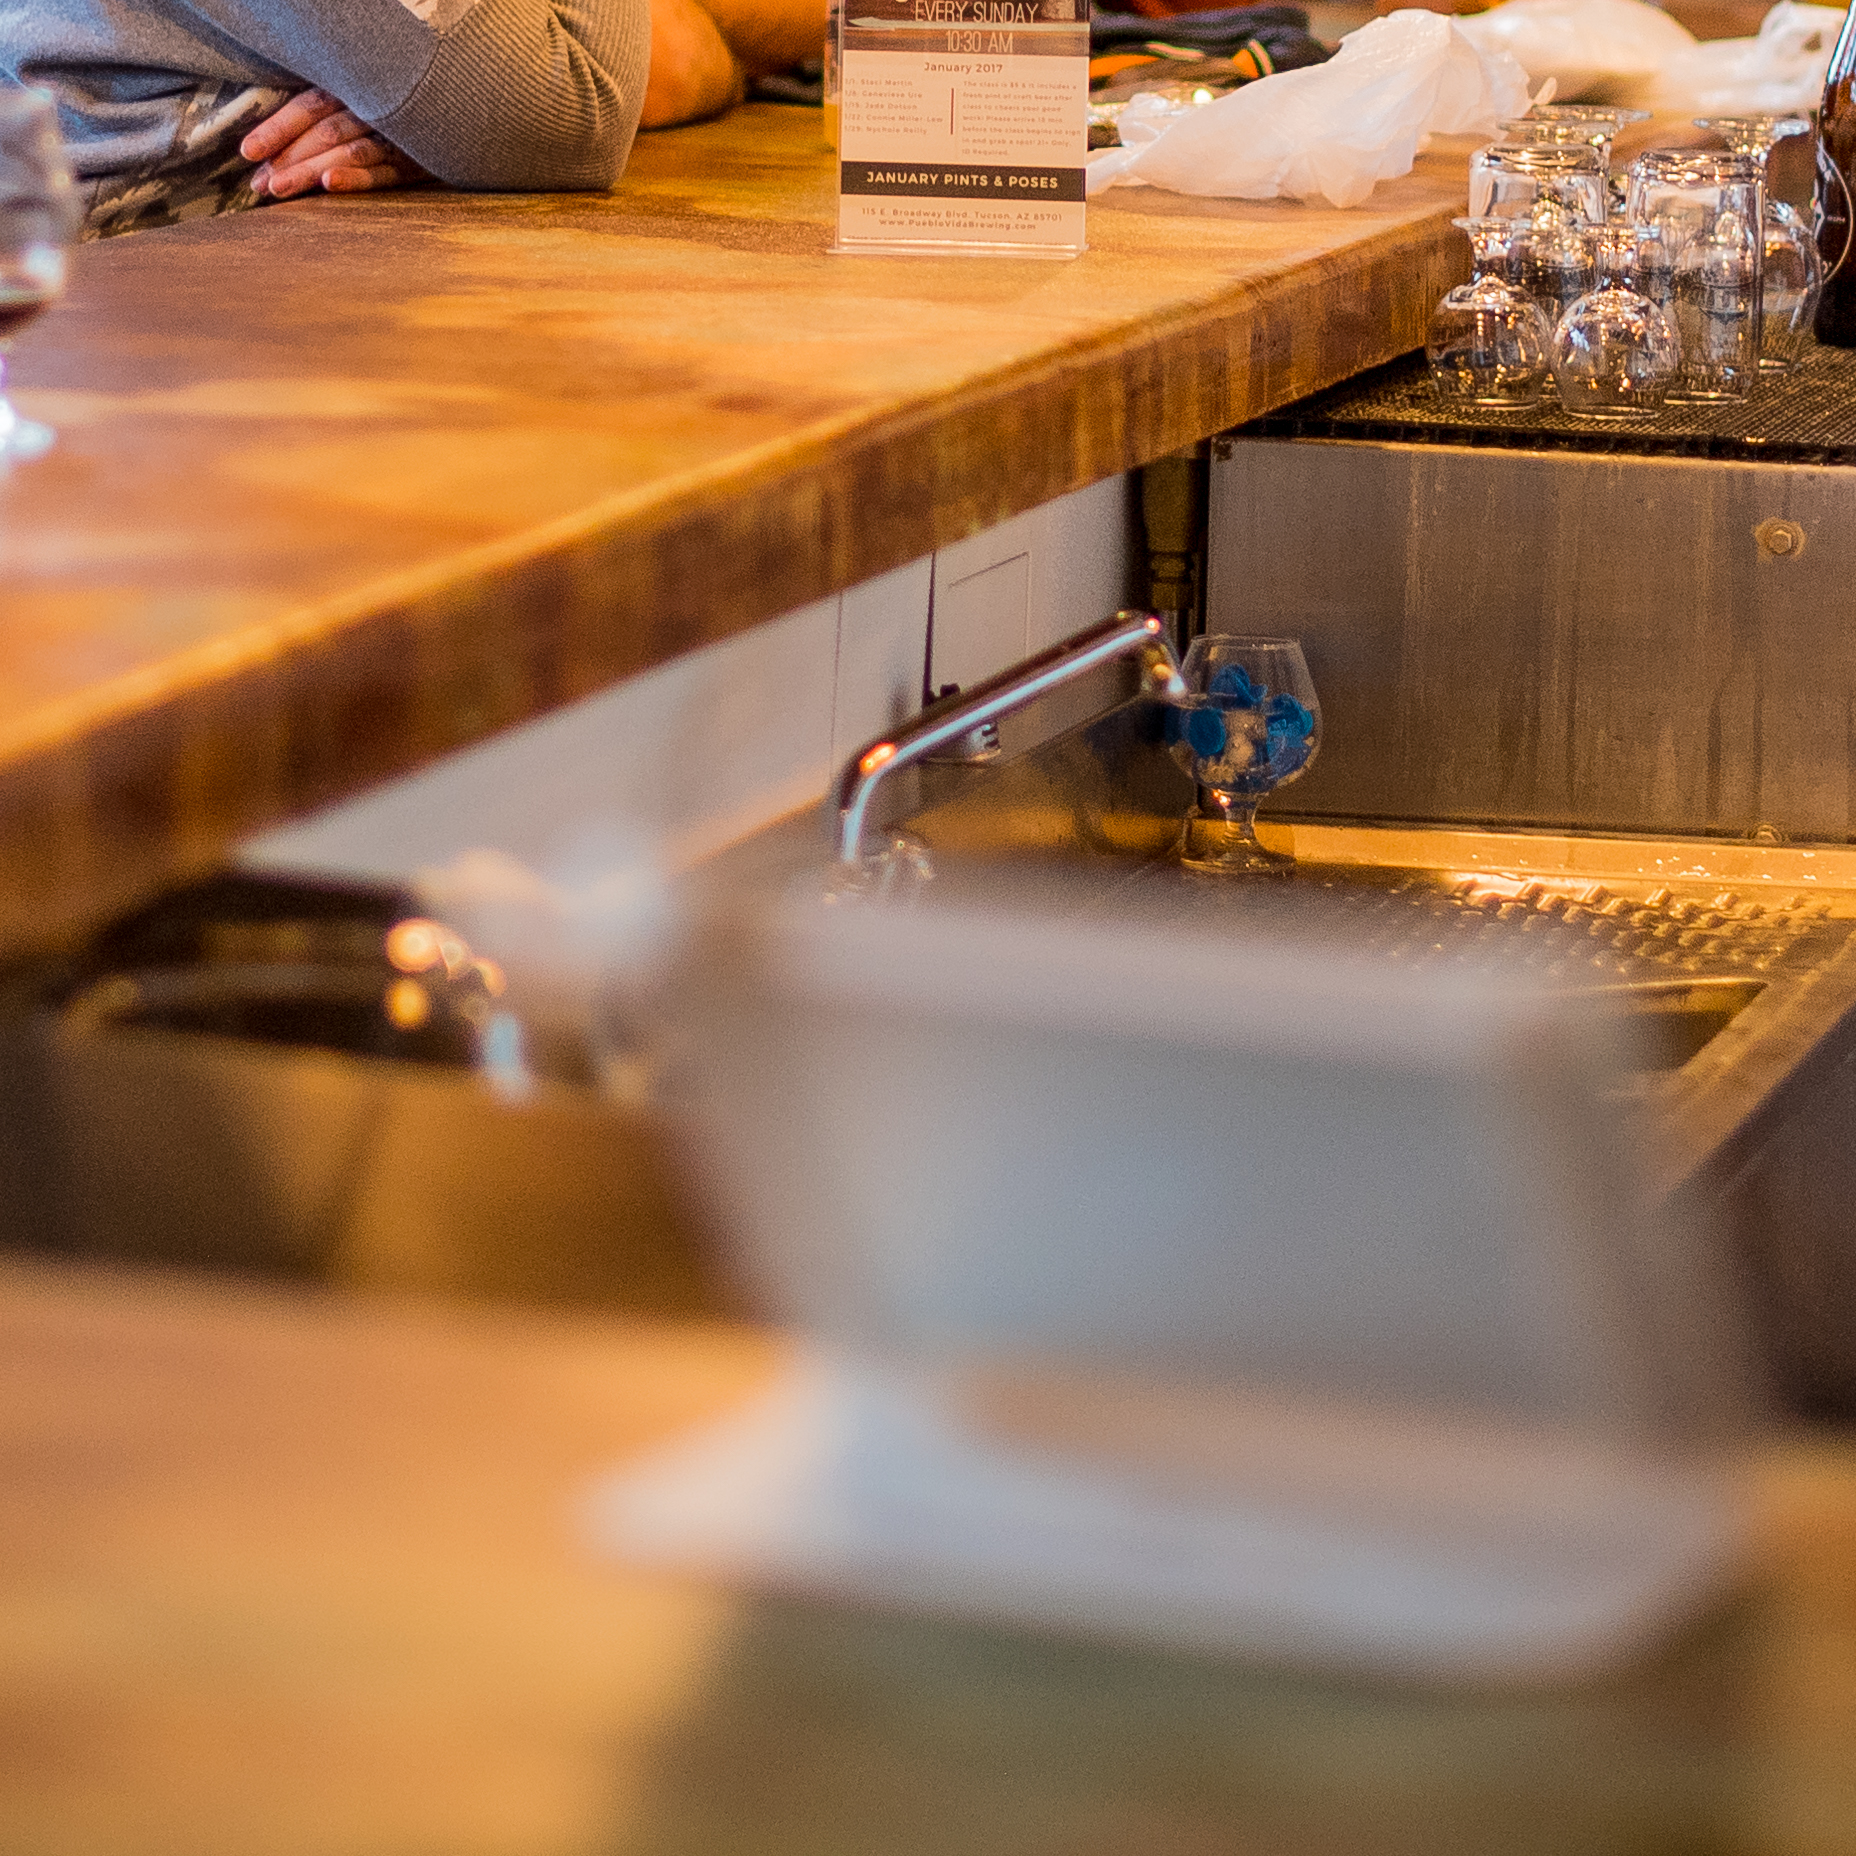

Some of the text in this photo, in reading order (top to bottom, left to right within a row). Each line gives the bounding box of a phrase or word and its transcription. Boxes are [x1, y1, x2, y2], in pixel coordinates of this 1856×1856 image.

[915, 0, 1038, 23] EVERY SUNDAY
[946, 30, 1012, 53] 10:30 AM
[925, 62, 1003, 74] January 2017
[867, 171, 1058, 188] JANUARY PINTS & POSES
[893, 209, 942, 219] Broadway
[1034, 213, 1062, 221] 85701
[879, 219, 1036, 231] www.PuebloVidaBrewing.com
